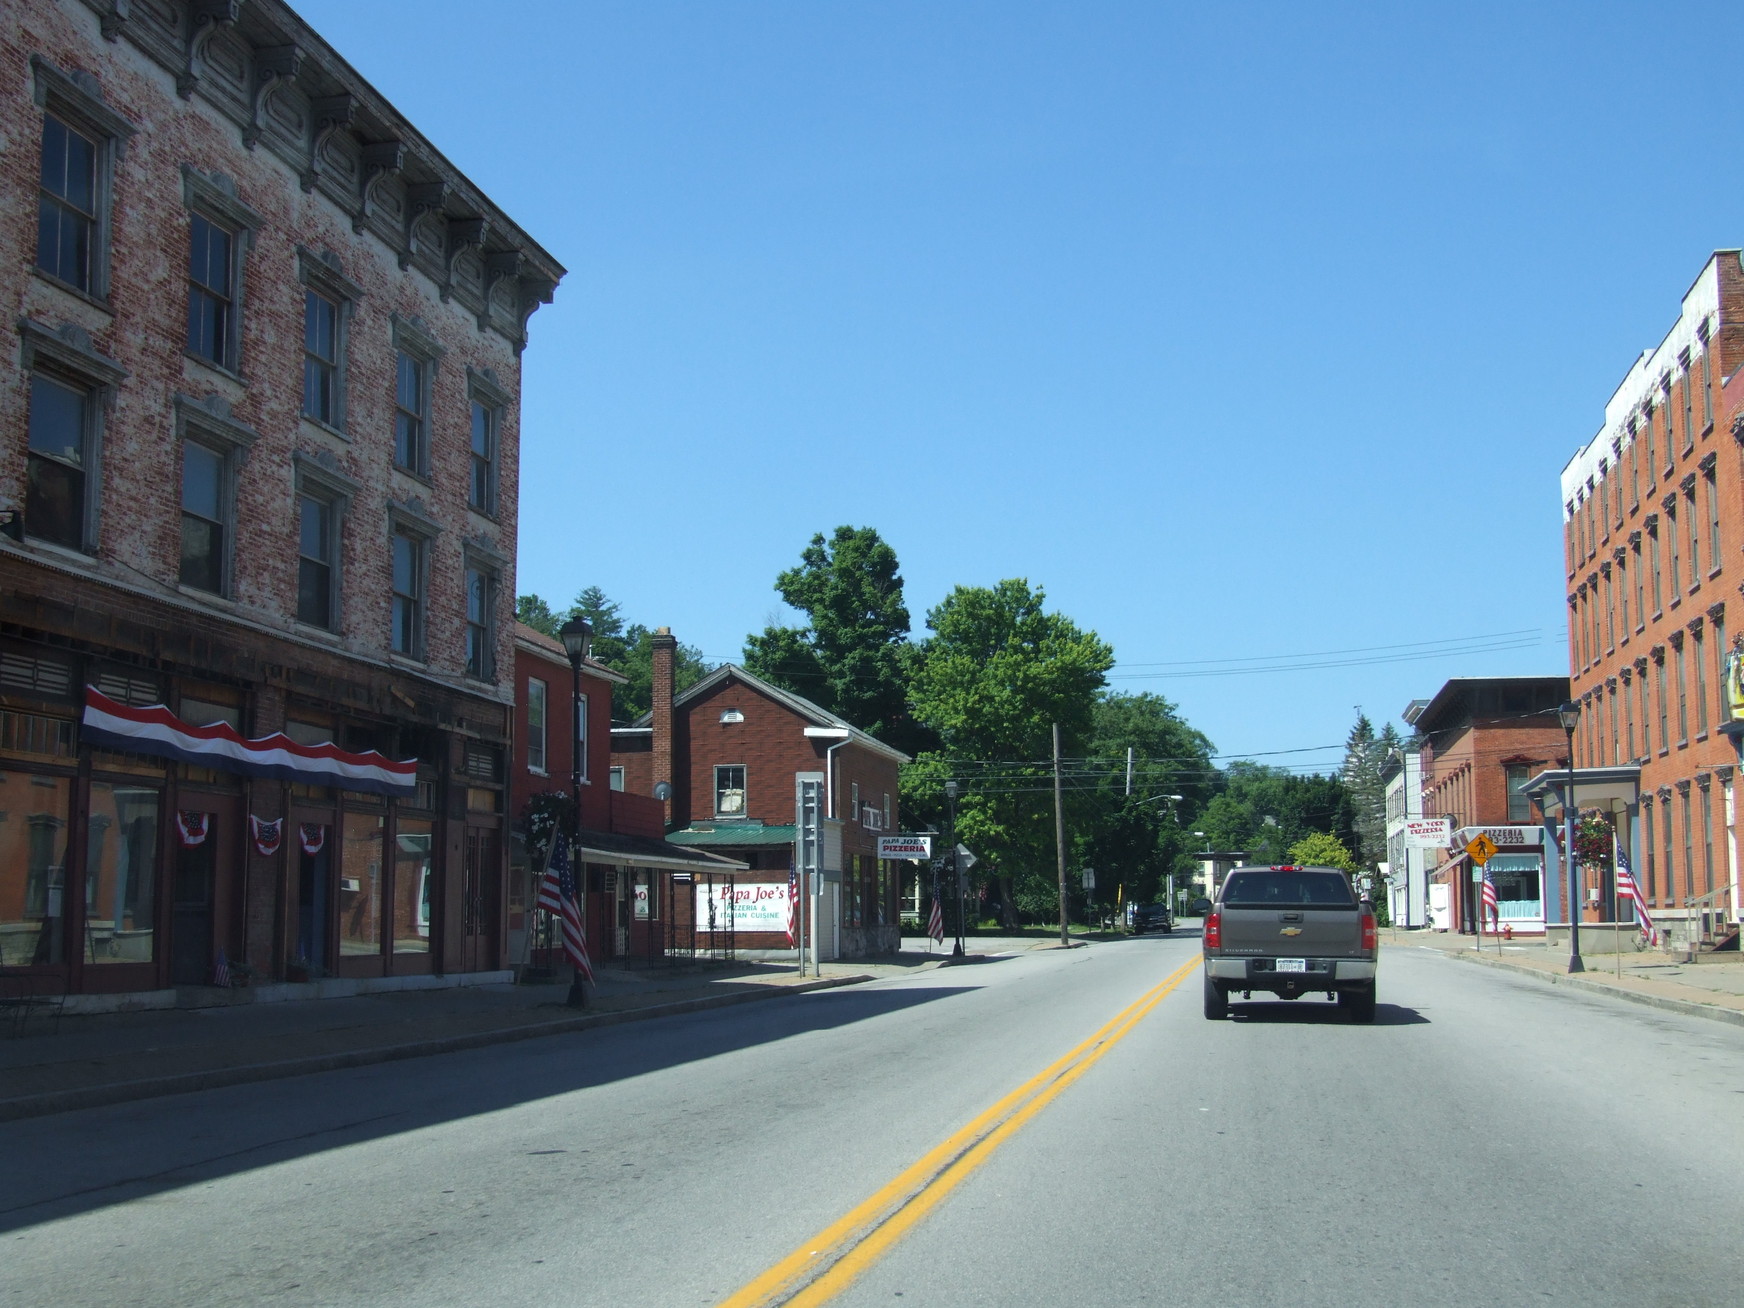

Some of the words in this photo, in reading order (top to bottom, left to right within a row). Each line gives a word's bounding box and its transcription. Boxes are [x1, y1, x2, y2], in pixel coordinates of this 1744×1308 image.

[1482, 829, 1523, 837] PIZZERIA
[720, 885, 750, 903] Papa
[752, 886, 784, 903] Joe's
